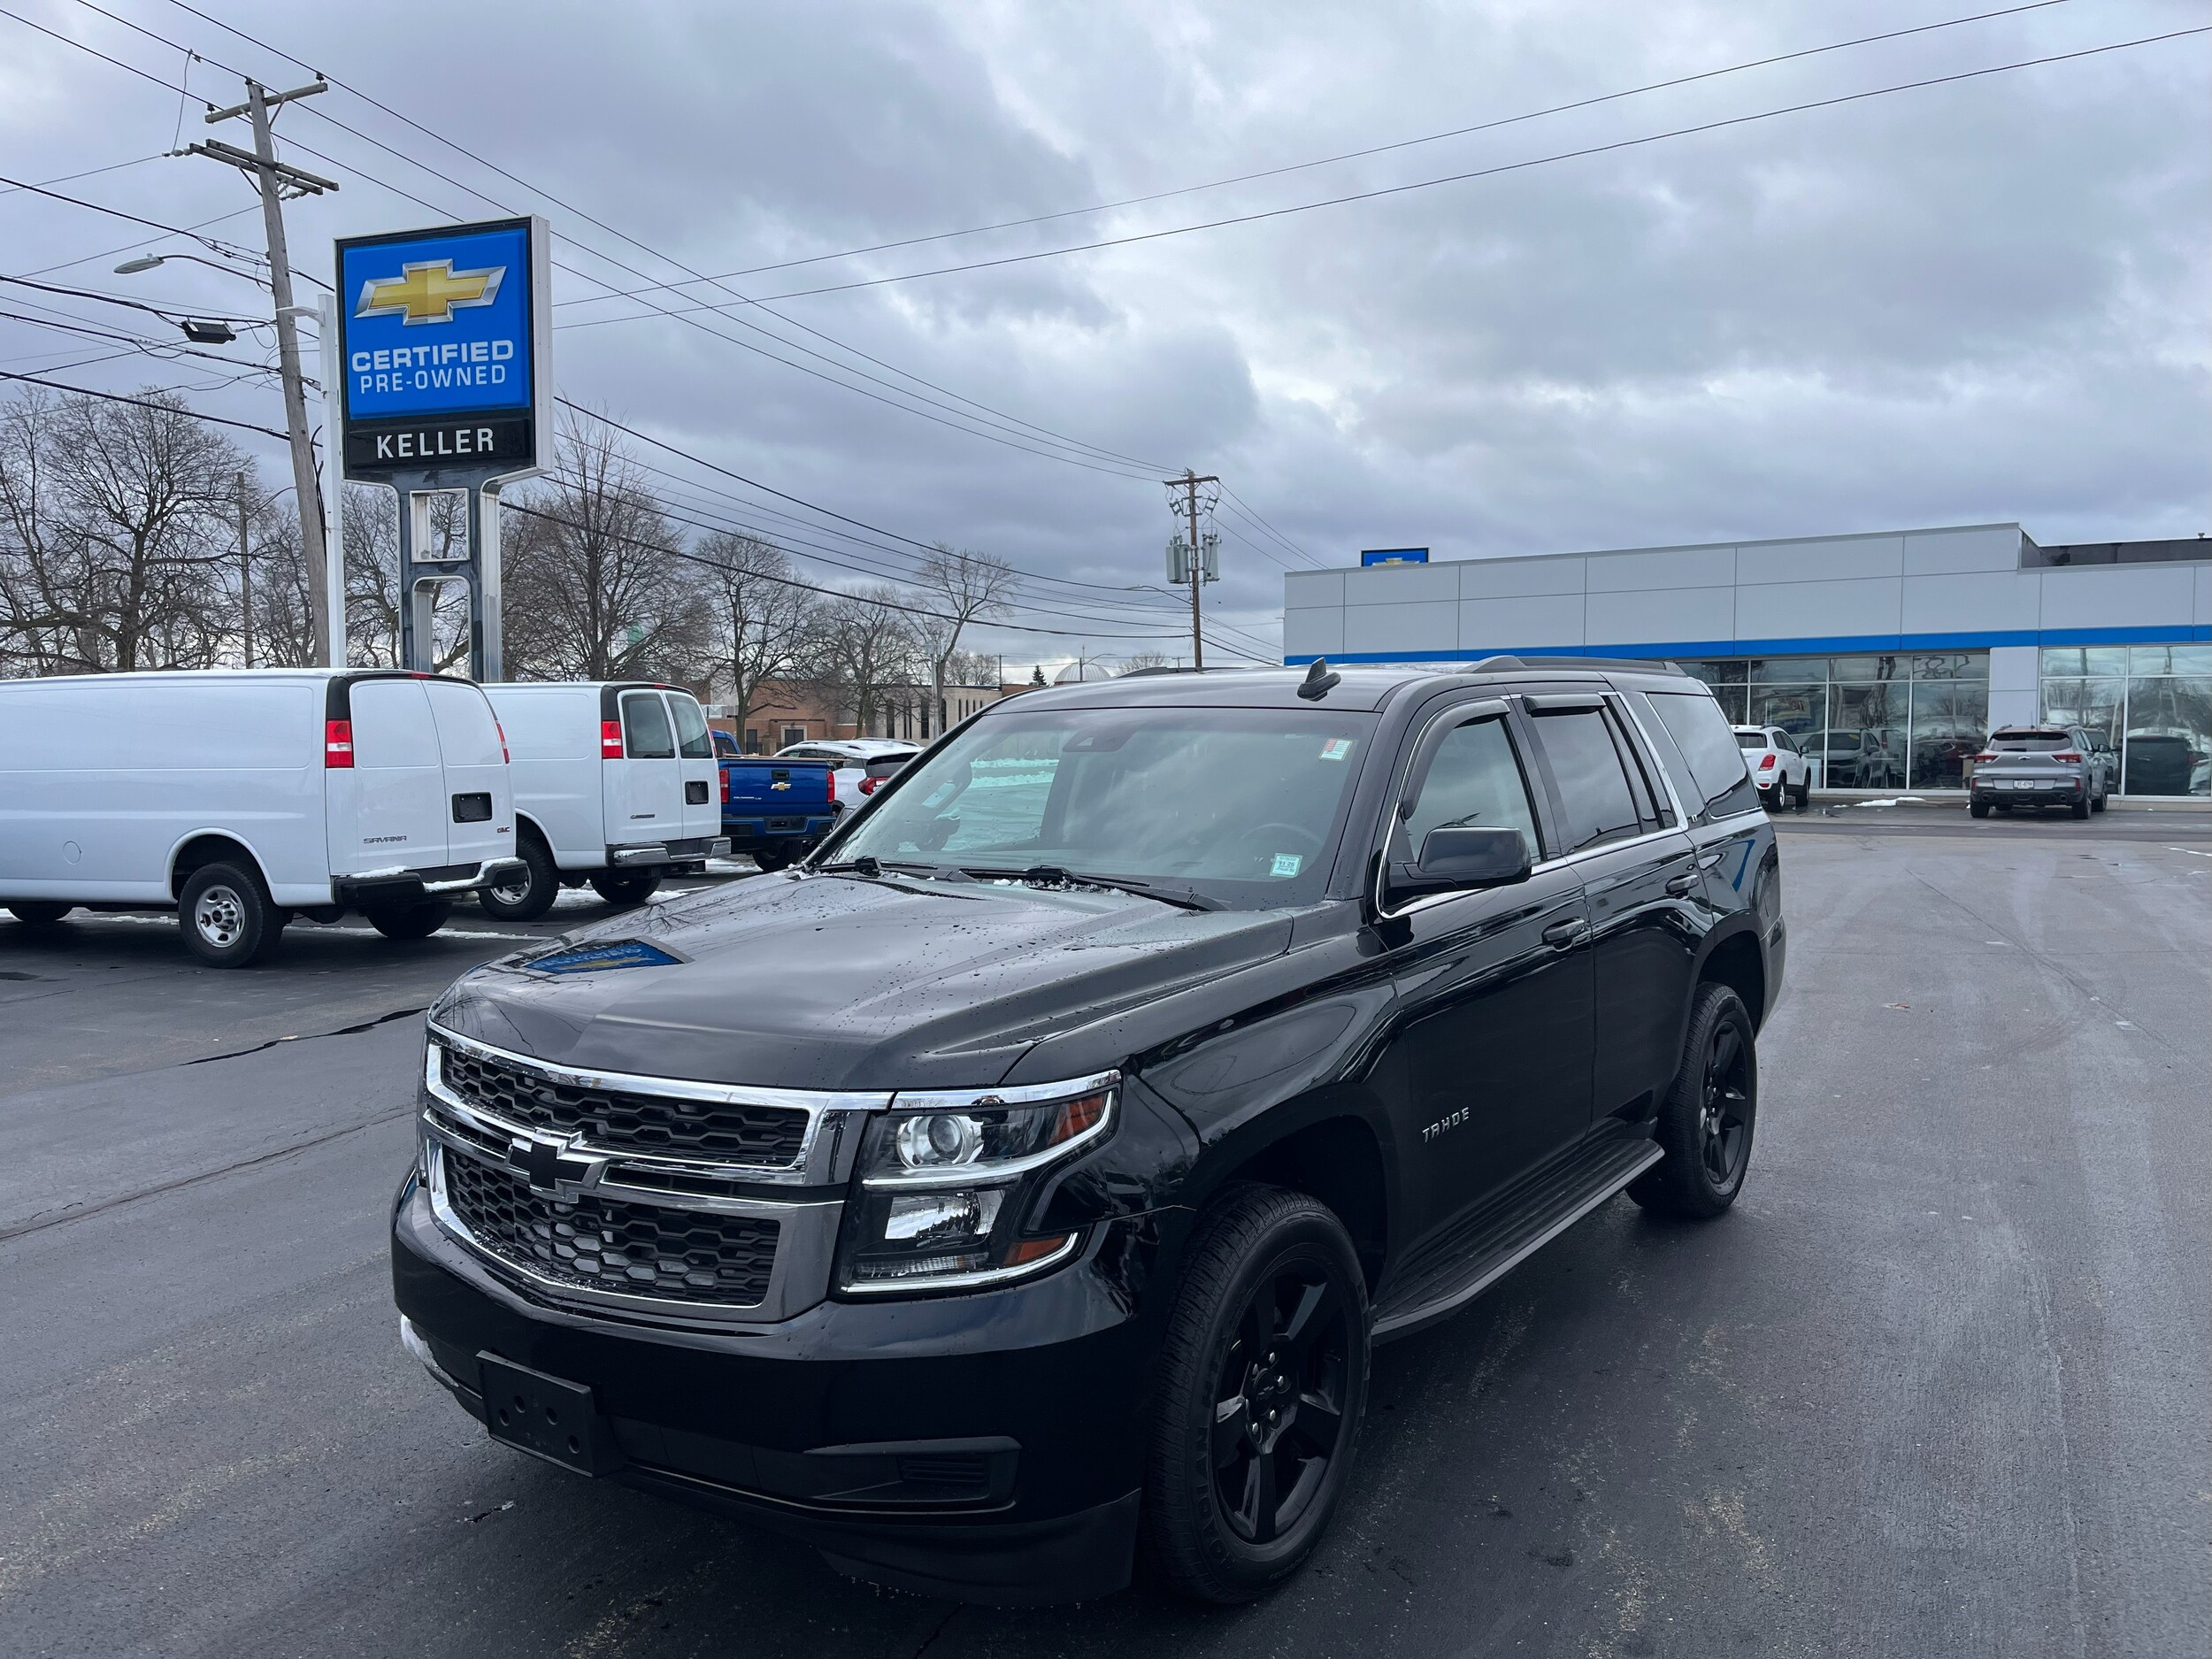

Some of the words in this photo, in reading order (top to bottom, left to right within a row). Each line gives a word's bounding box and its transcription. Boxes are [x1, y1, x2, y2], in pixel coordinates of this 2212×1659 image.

[352, 340, 513, 373] CERTIFIED
[360, 365, 506, 394] PRE-OWNED
[377, 427, 494, 458] KELLER
[363, 835, 407, 844] SAVANA
[1422, 1107, 1469, 1143] TAHOE
